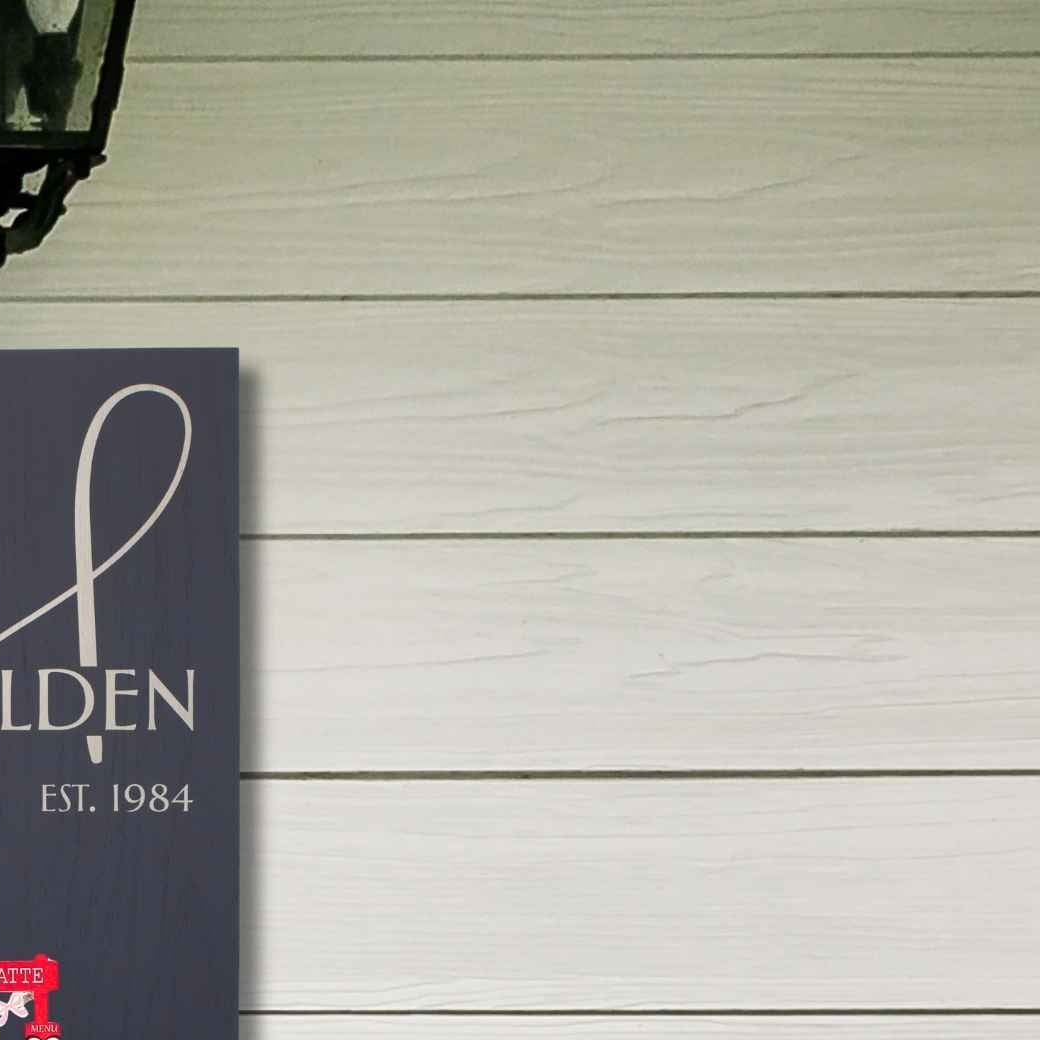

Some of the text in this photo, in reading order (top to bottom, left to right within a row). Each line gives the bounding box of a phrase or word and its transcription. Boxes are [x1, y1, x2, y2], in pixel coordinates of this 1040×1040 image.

[41, 783, 194, 812] EST. 1984
[30, 1024, 58, 1033] MENU
